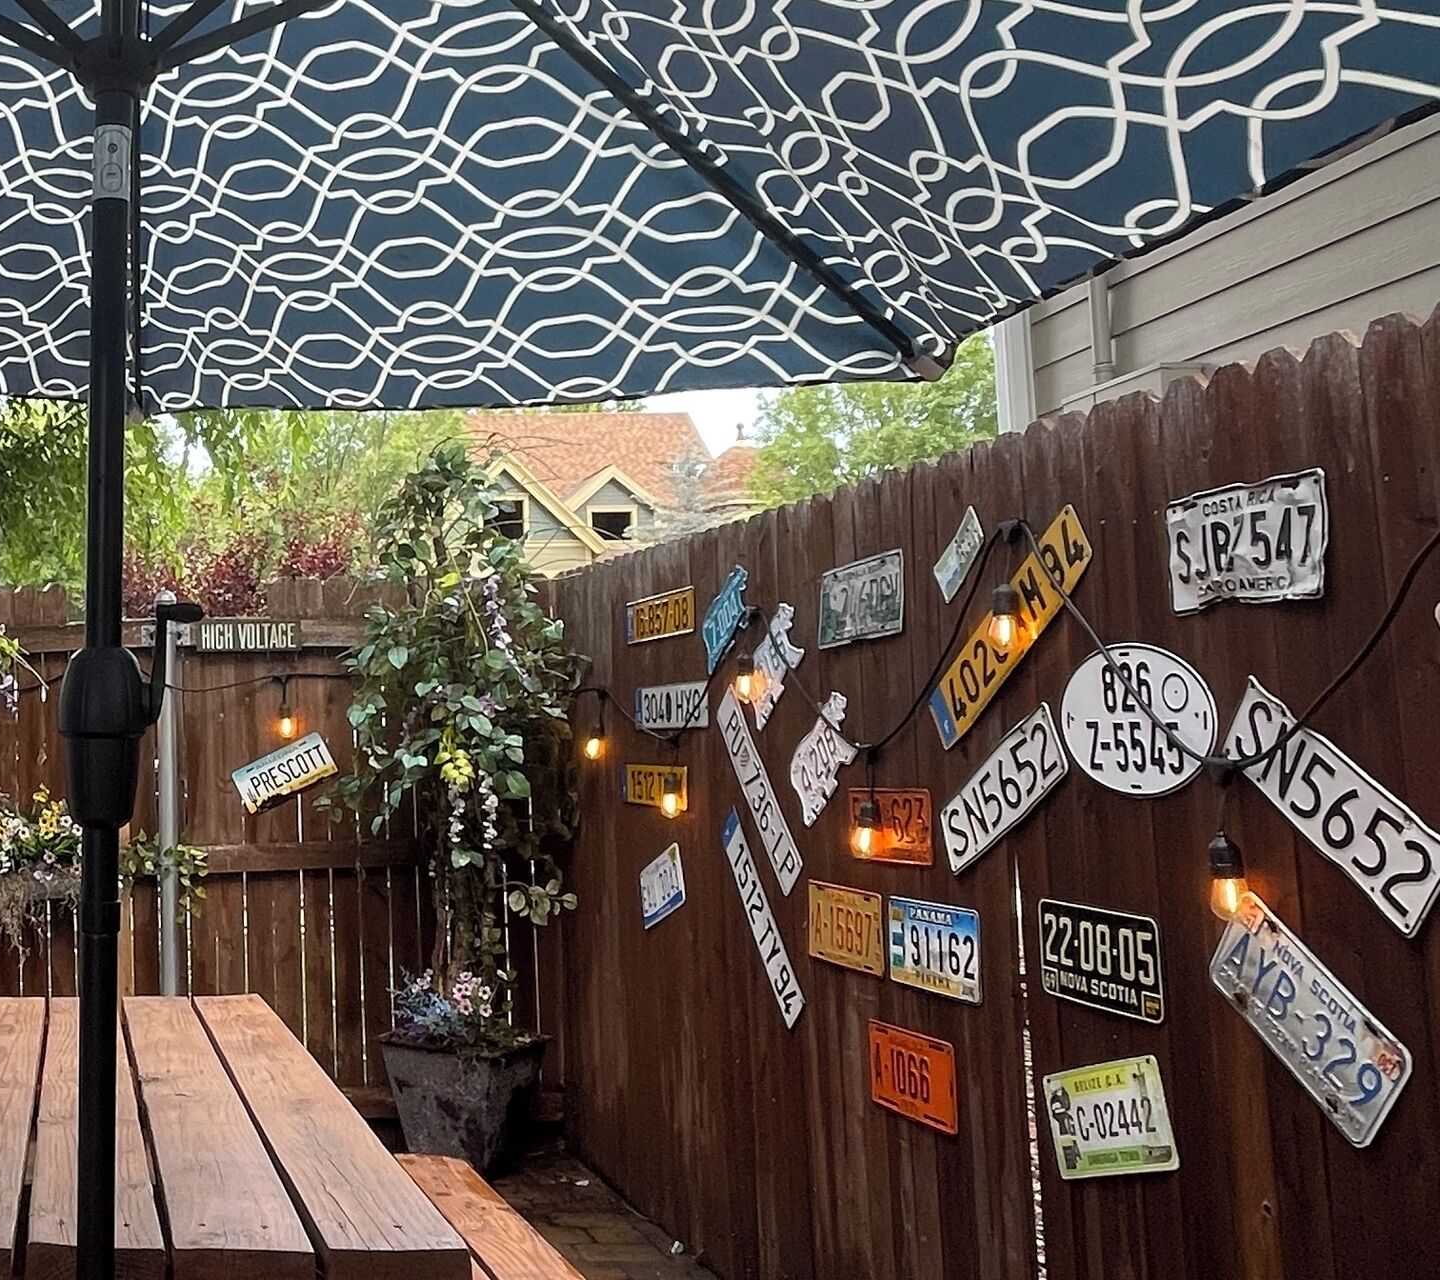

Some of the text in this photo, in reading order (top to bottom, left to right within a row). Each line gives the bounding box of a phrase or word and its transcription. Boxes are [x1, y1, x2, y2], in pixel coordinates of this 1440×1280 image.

[1202, 487, 1276, 517] COSTA RICA
[201, 623, 297, 650] HIGH VOLTAGE
[1101, 661, 1152, 714] 826
[250, 744, 327, 798] PRESCOTT
[947, 722, 1058, 858] SN5652
[1235, 701, 1432, 918] SN5652
[732, 843, 799, 1014] 1512 TY 94
[908, 906, 953, 927] PANAMA
[1060, 971, 1138, 1006] NOVA SCOTIA
[1272, 940, 1357, 1035] NOVA SCOTIA
[1223, 932, 1382, 1108] AYB-329
[1076, 1096, 1156, 1141] C-02442
